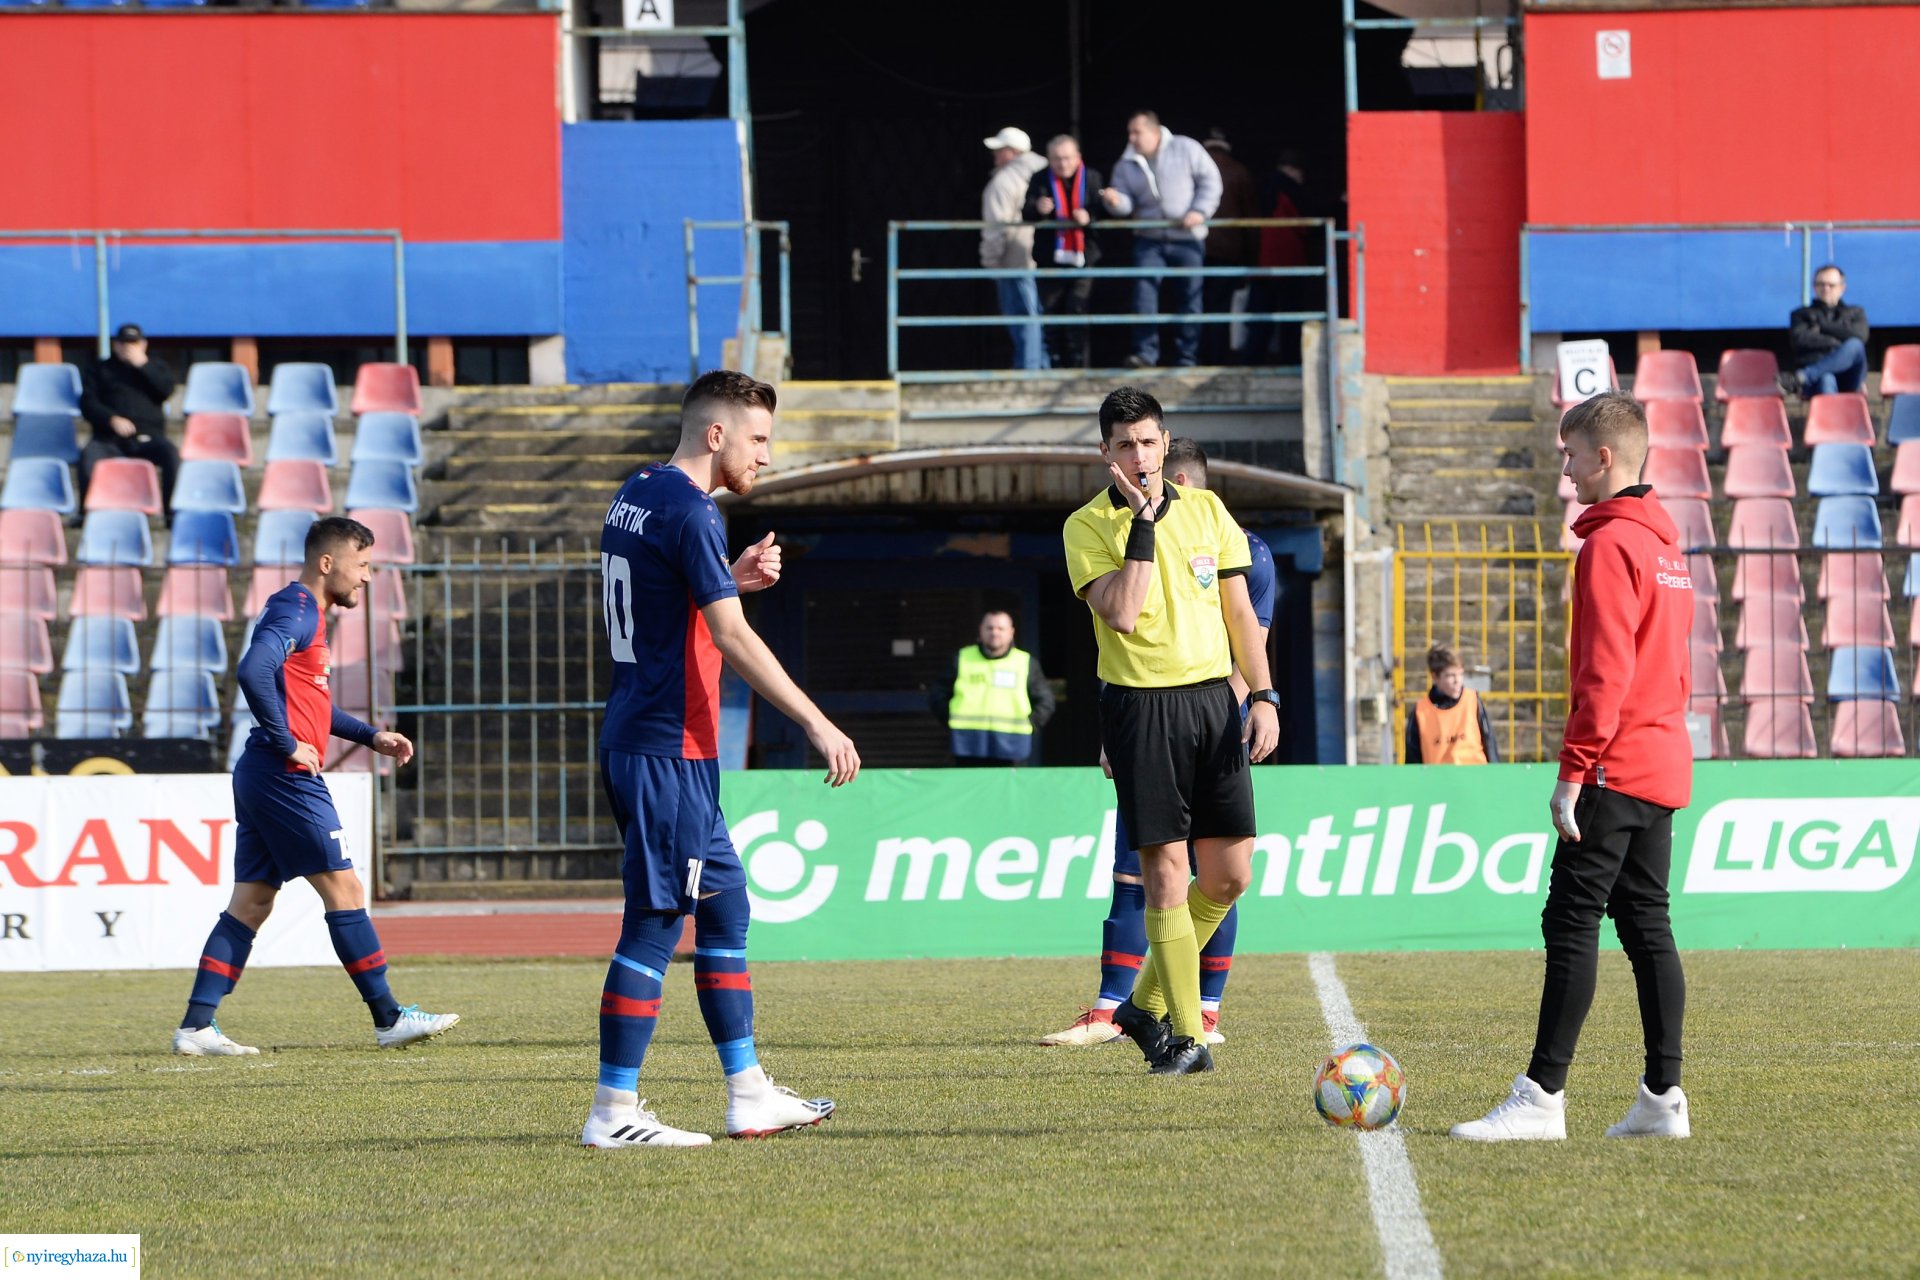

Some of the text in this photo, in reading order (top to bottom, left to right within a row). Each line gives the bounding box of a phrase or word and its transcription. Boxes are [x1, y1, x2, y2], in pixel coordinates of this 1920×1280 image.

[637, 0, 661, 21] A
[1575, 367, 1597, 396] C
[601, 551, 638, 664] 10
[1713, 818, 1898, 871] LIGA
